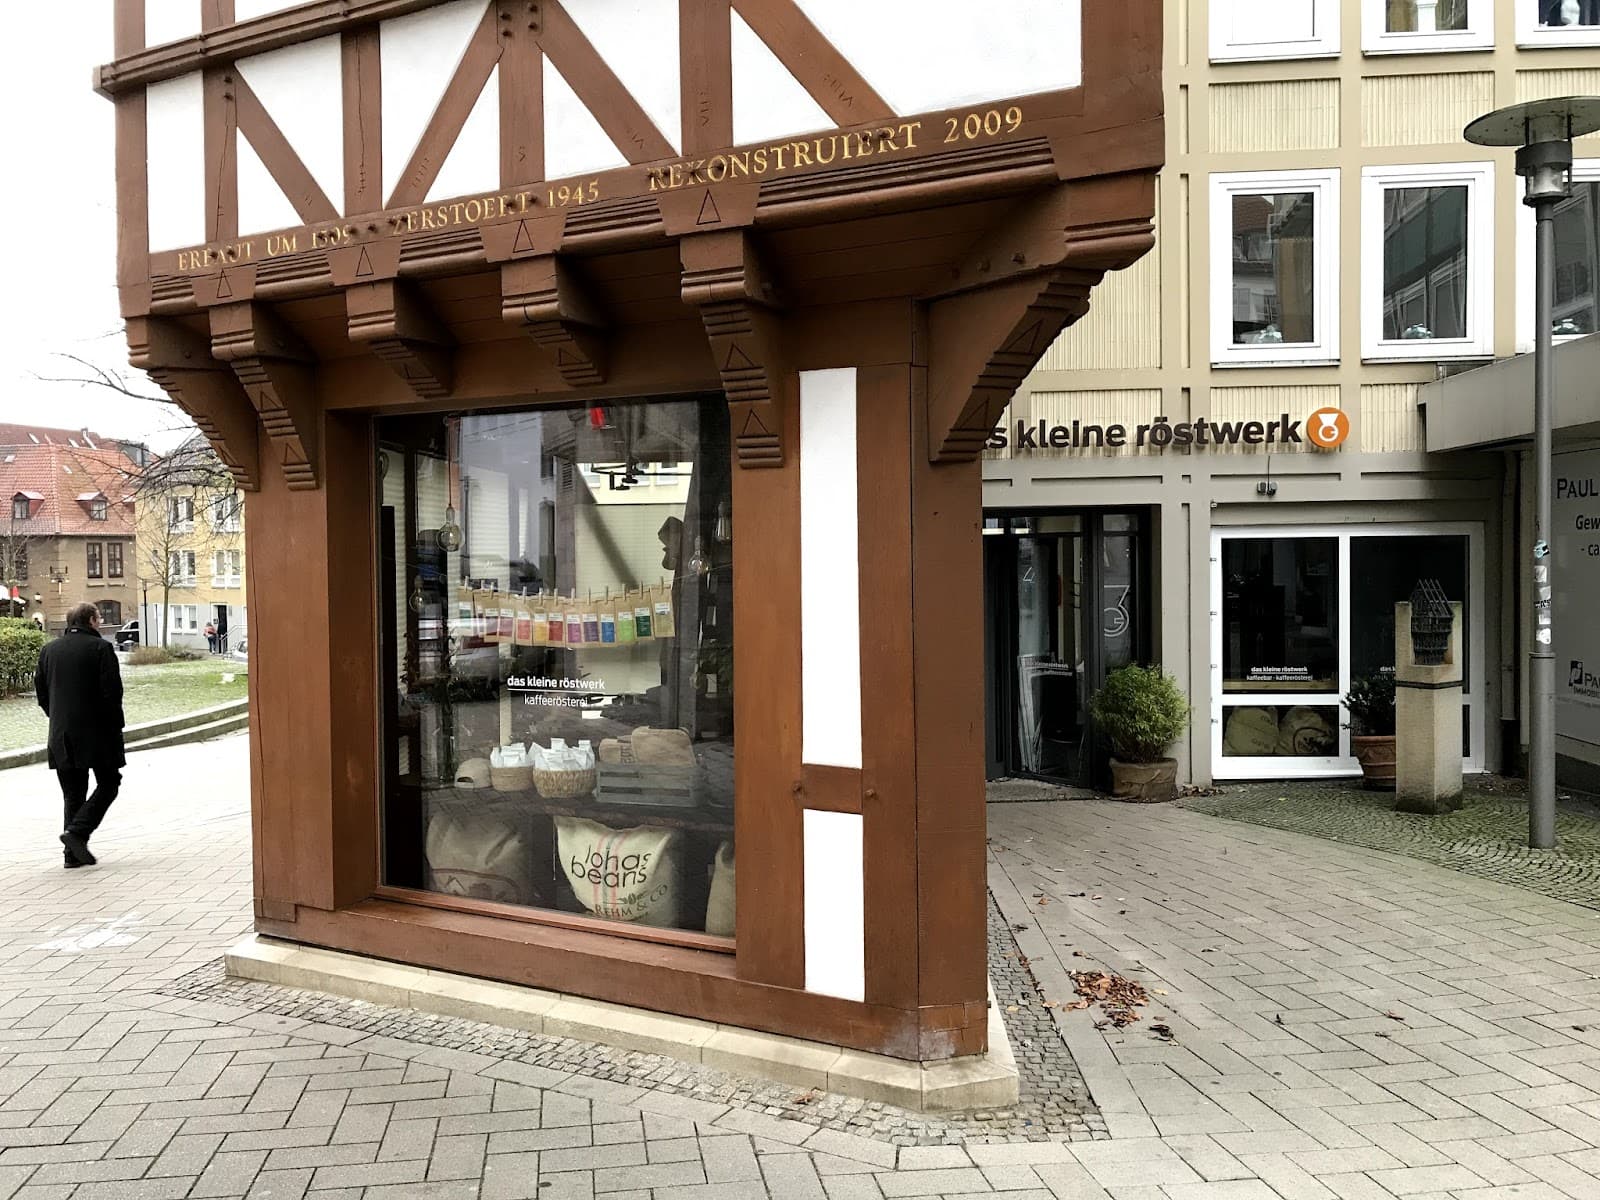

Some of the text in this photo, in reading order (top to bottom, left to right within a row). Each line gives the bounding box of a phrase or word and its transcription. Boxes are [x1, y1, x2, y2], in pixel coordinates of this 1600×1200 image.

[267, 233, 297, 256] UM
[388, 191, 532, 235] ZERSTOERT
[547, 179, 600, 209] 1945
[646, 121, 921, 191] REKONSTRUIERT
[944, 105, 1023, 143] 2009
[1017, 419, 1127, 449] kleine
[1136, 413, 1303, 448] röstwerk
[1556, 477, 1599, 499] PAUL
[507, 675, 605, 689] das kleine röstwerk
[524, 693, 588, 707] kaffeerösterei
[571, 855, 647, 888] beans
